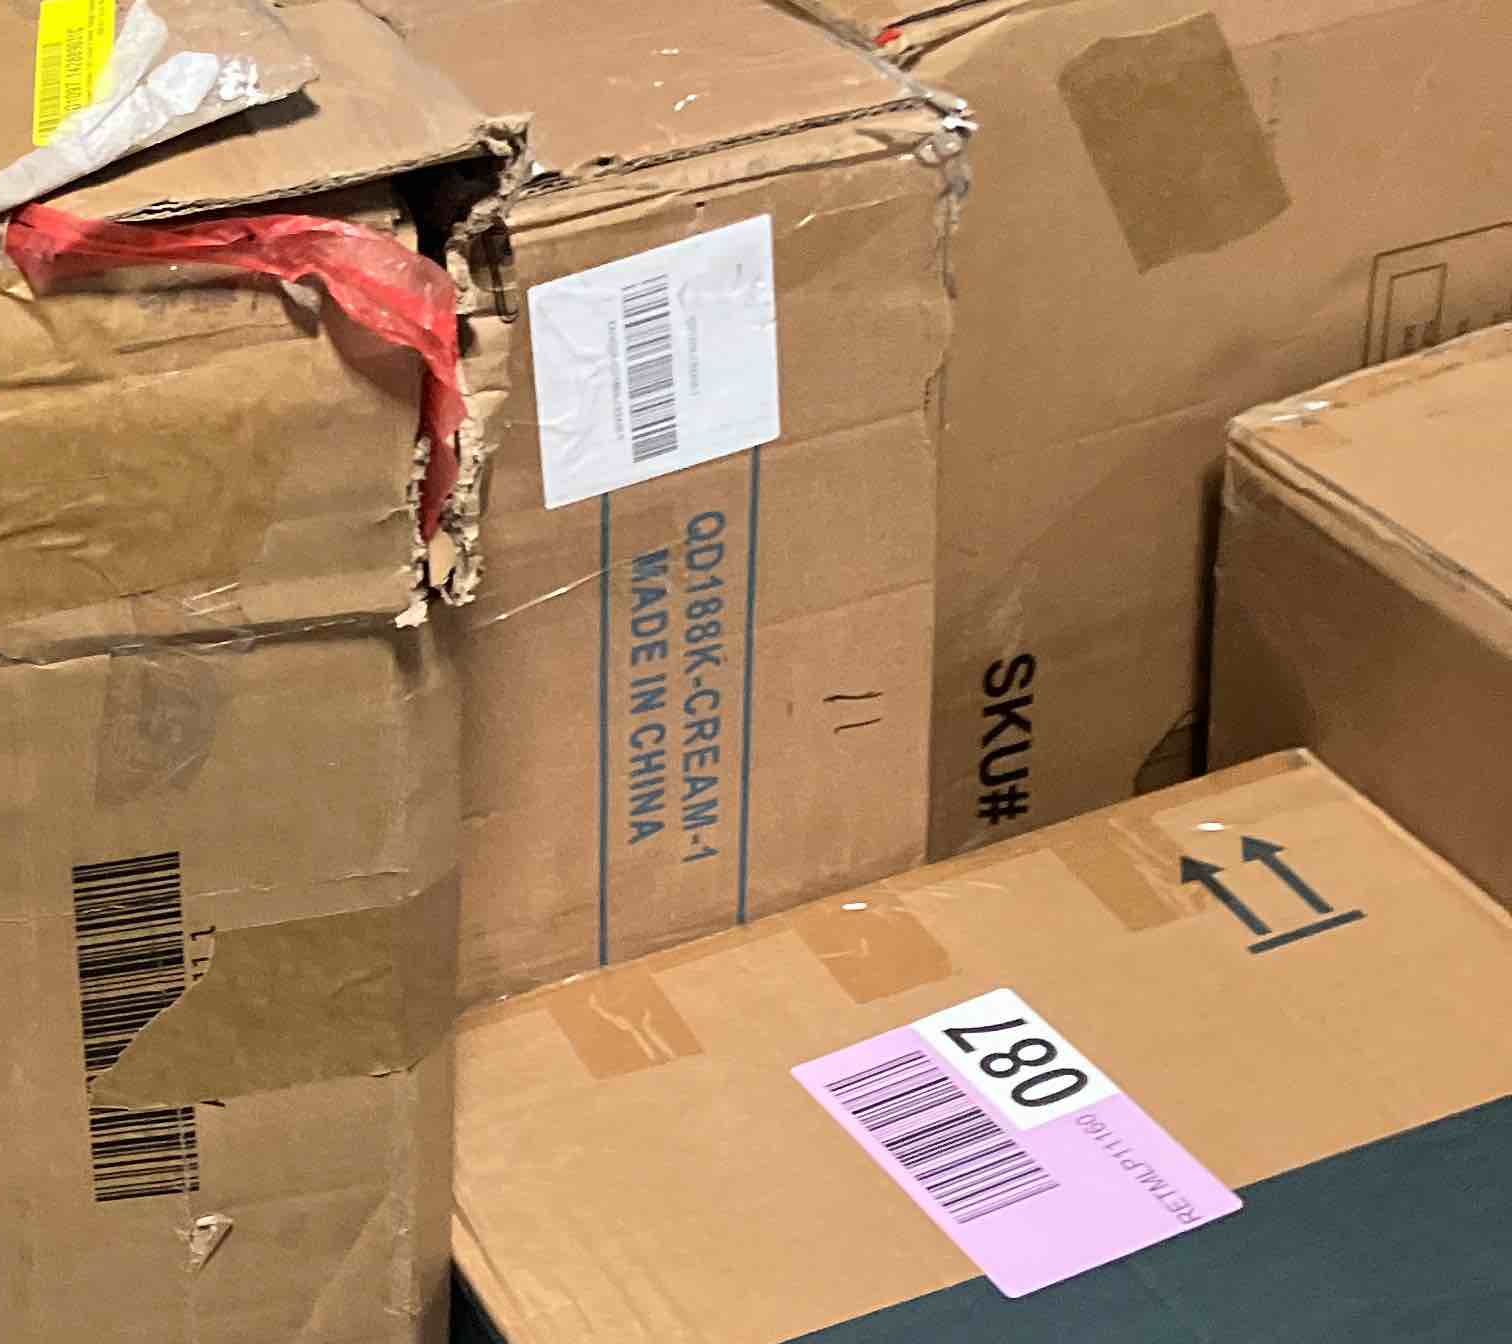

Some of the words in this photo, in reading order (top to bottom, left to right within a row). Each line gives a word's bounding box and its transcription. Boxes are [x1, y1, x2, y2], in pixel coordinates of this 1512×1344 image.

[630, 548, 672, 664] MADE
[629, 675, 668, 717] IN
[682, 510, 728, 865] QD188K-CREAM-1
[976, 652, 1037, 825] SKU#
[626, 722, 668, 846] CHINA
[943, 1016, 1089, 1110] 087
